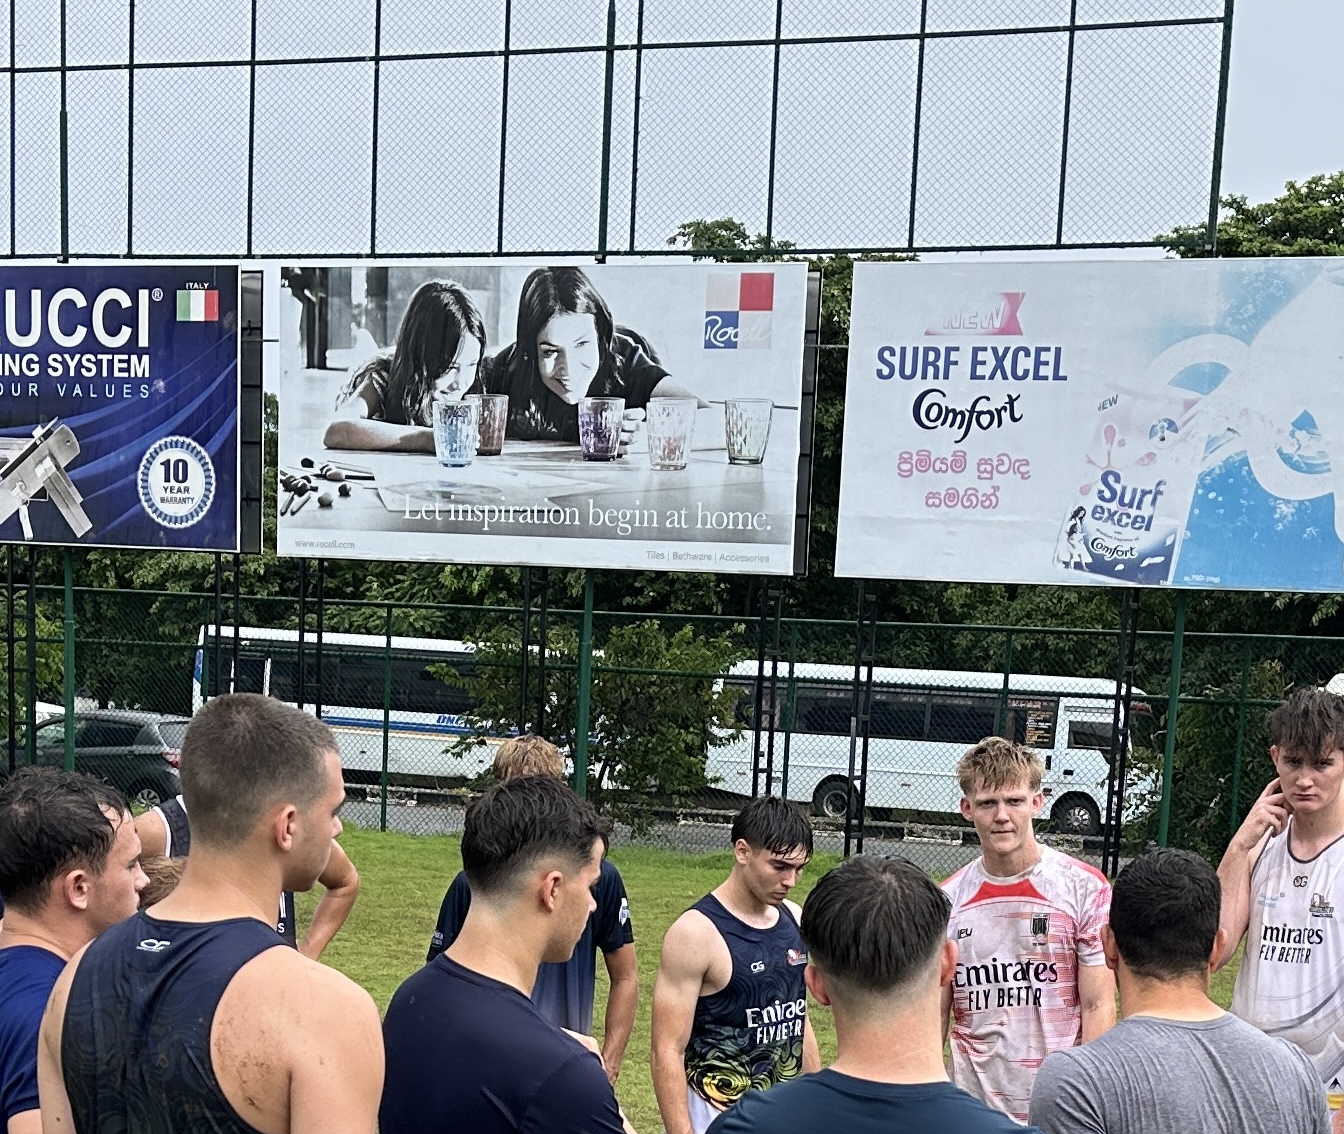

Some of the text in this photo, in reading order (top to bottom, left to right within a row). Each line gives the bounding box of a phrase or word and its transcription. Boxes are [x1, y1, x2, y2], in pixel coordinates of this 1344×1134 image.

[185, 282, 210, 291] ITALY
[47, 353, 150, 378] SYSTEM
[876, 346, 1068, 382] SURF EXCEL
[57, 382, 150, 399] VALUES
[912, 388, 1024, 443] Comfort
[159, 458, 189, 484] 10
[162, 485, 191, 495] YEAR
[1097, 469, 1167, 512] Surf
[402, 493, 773, 535] Let inspiration begin at home.
[1091, 503, 1155, 532] excel
[1090, 537, 1137, 559] Comfort
[1259, 944, 1277, 961] FLY
[968, 988, 991, 1011] FLY
